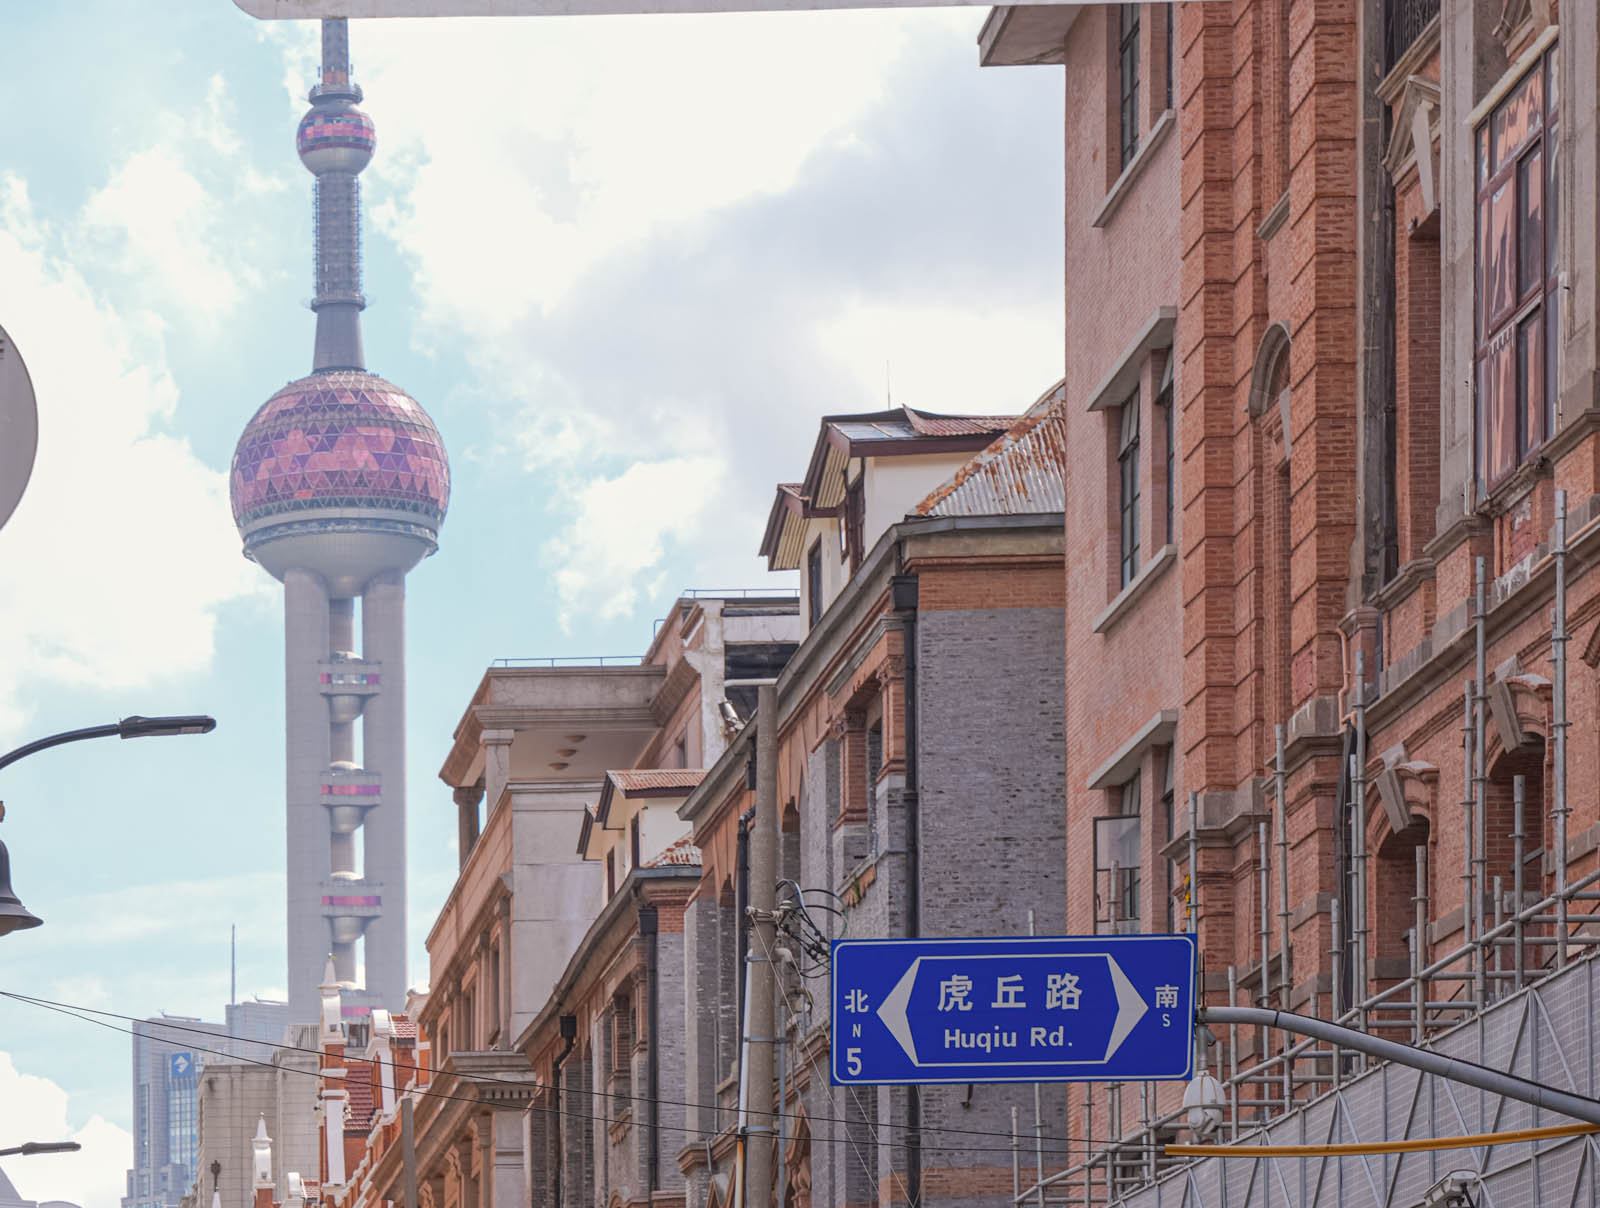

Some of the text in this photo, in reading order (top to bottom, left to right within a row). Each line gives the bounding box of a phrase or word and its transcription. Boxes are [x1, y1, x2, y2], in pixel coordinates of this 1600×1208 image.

[844, 988, 869, 1014] 北
[937, 972, 1083, 1012] 虎丘路
[1154, 984, 1179, 1010] 南
[852, 1023, 861, 1038] N
[1162, 1013, 1171, 1028] S
[944, 1025, 1074, 1053] Huqiu Rd.
[847, 1047, 862, 1077] 5
